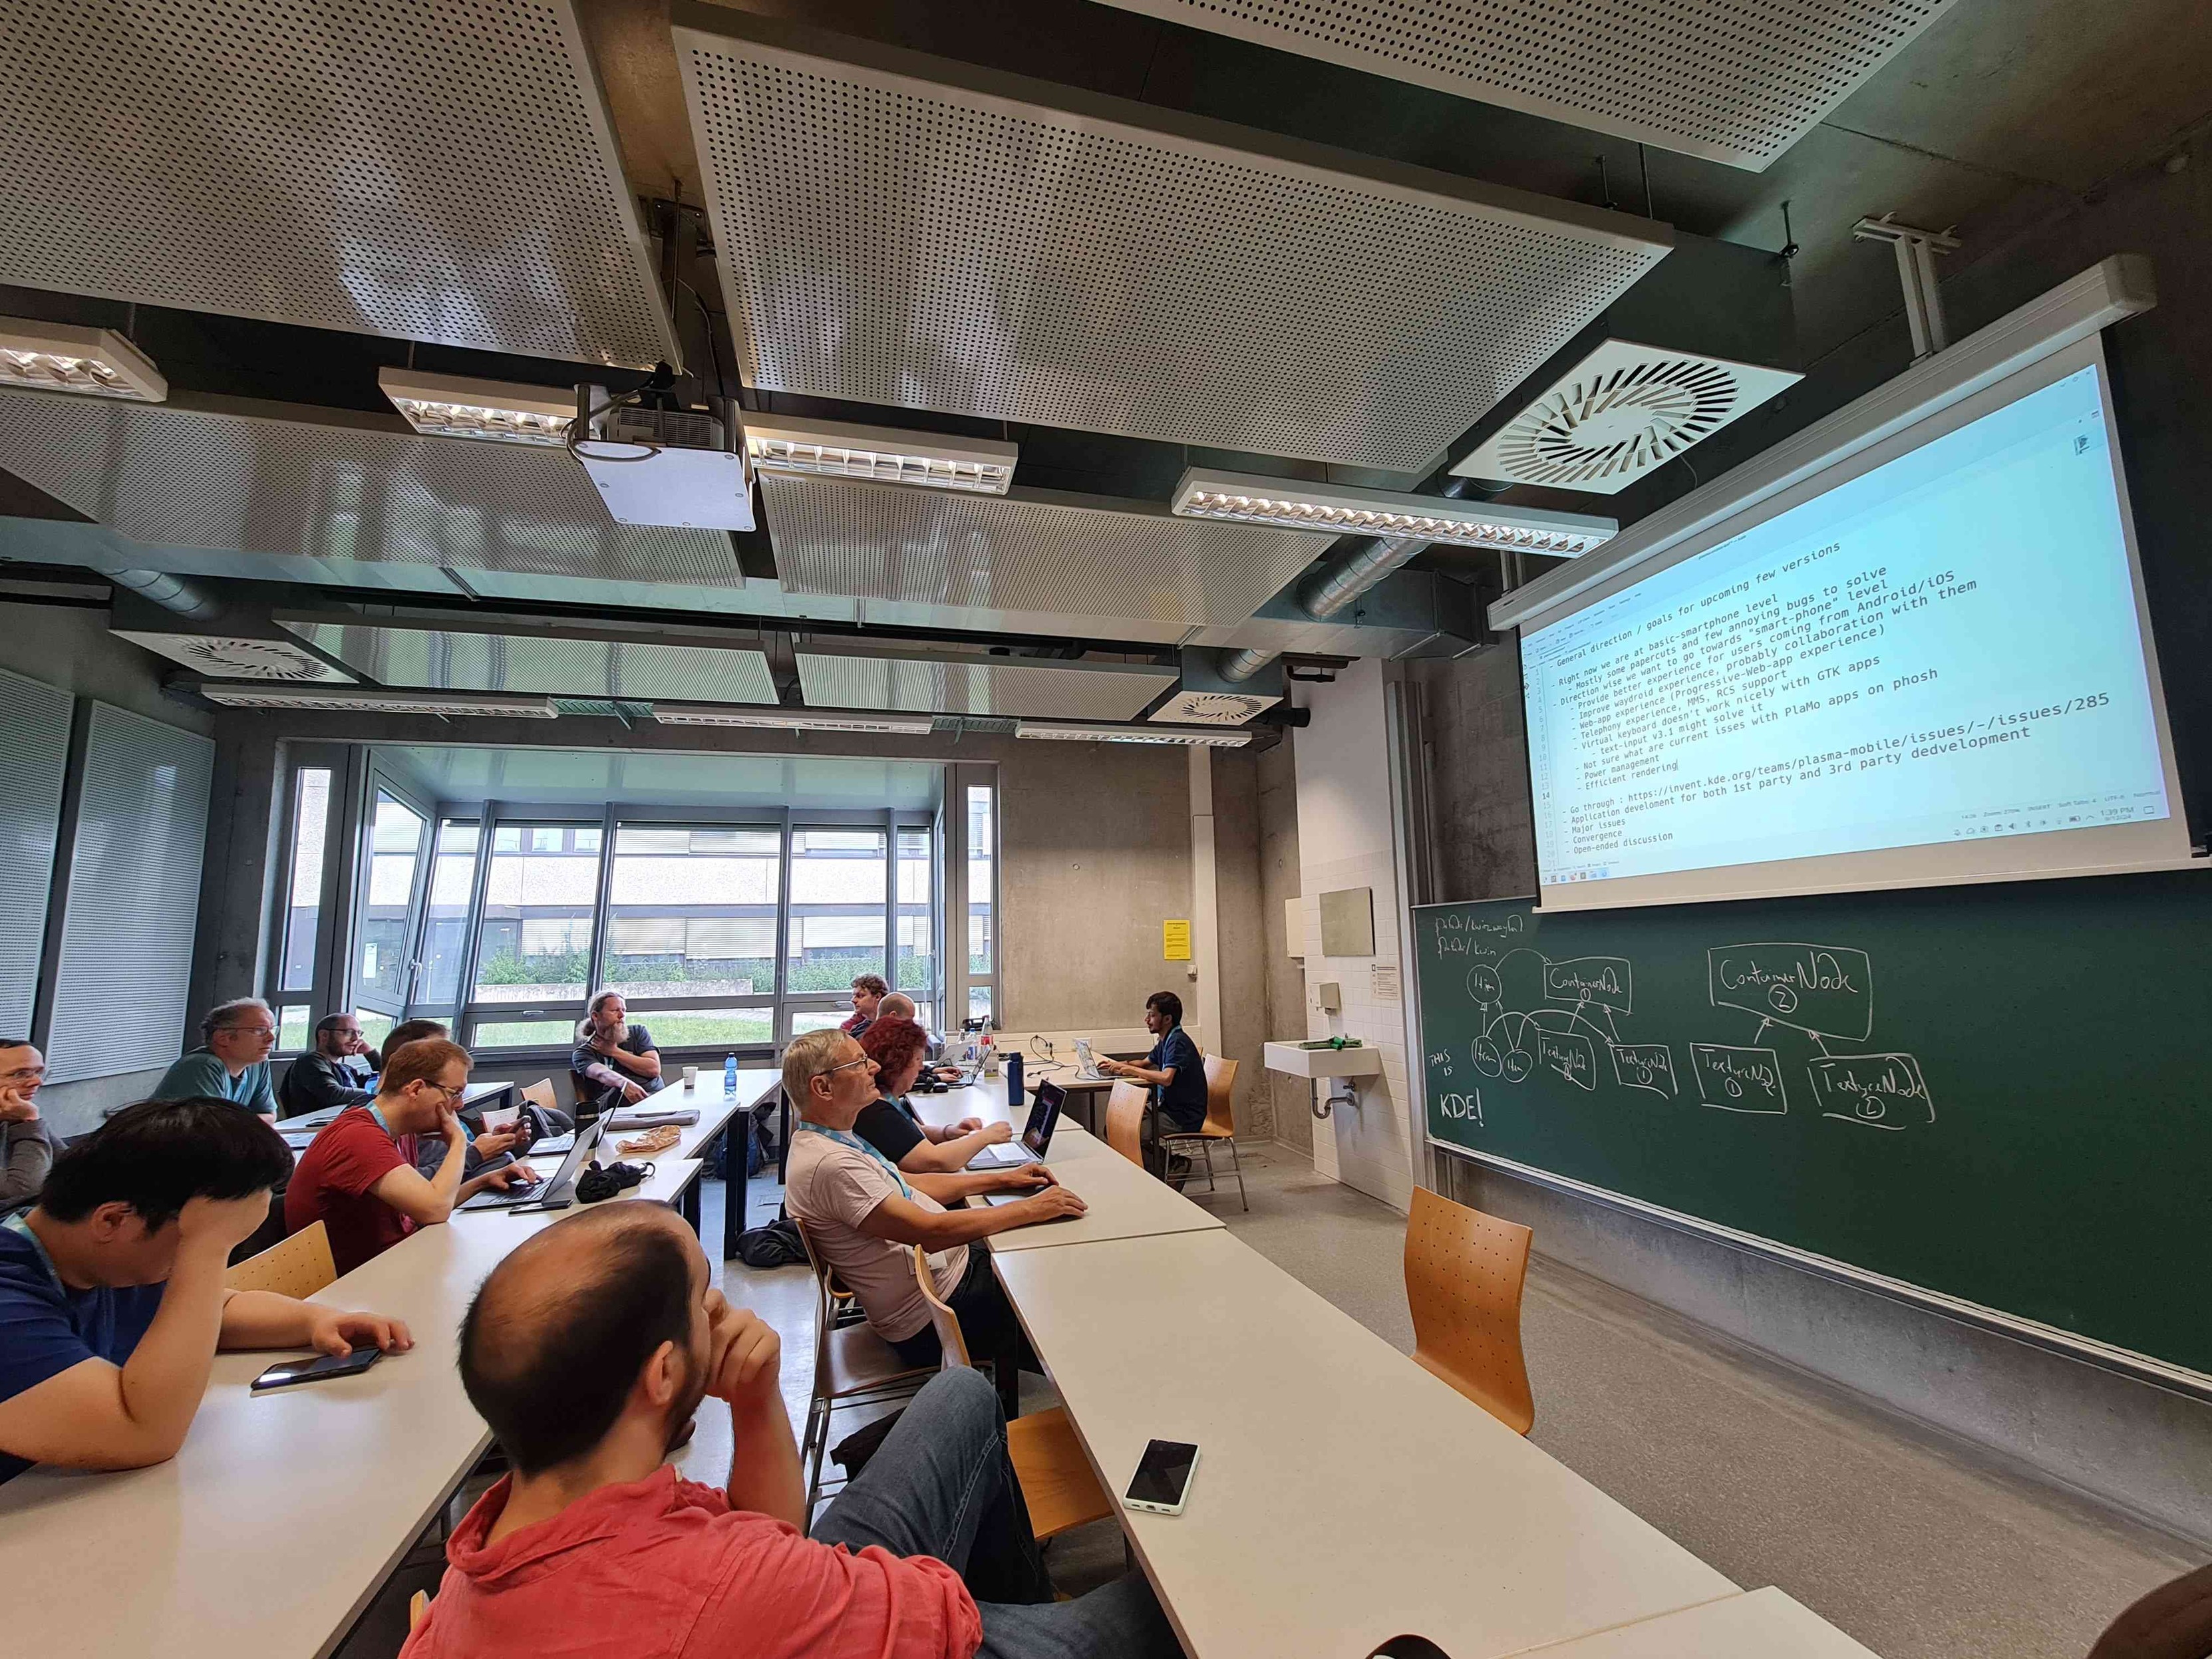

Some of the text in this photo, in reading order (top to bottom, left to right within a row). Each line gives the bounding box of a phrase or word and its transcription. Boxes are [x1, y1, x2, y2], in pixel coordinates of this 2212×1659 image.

[1557, 649, 1586, 667] General
[1591, 631, 1632, 653] direction
[1647, 613, 1672, 631] goals
[1678, 604, 1694, 616] for
[1700, 581, 1749, 607] upcoming
[1756, 569, 1775, 583] few
[1782, 543, 1839, 572] versions
[1559, 673, 1579, 686] Right
[1584, 666, 1597, 676] now
[1615, 654, 1629, 664] are
[1634, 647, 1643, 657] at
[1649, 611, 1739, 651] basic-smartphone
[1746, 593, 1778, 613] level
[1561, 686, 1599, 705] Direction
[1603, 679, 1622, 689] wise
[1641, 663, 1660, 676] want
[1683, 652, 1694, 663] go
[1700, 635, 1741, 655] towards
[1749, 597, 1837, 635] "smart-phone"
[1847, 579, 1888, 601] level
[1576, 675, 1602, 689] Mostly
[1607, 666, 1625, 678] some
[1630, 647, 1676, 671] papercuts
[1682, 636, 1698, 650] and
[1704, 629, 1722, 641] few
[1728, 607, 1780, 632] annoying
[1787, 594, 1815, 611] bugs
[1822, 585, 1837, 596] to
[1846, 567, 1886, 588] solve
[1578, 693, 1609, 709] Provide
[1613, 682, 1641, 697] better
[1647, 661, 1700, 685] experience
[1708, 653, 1724, 664] for
[1731, 640, 1762, 656] users
[1770, 622, 1811, 643] coming
[1819, 609, 1849, 625] from
[1857, 570, 1954, 613] Android/iOS
[1579, 704, 1610, 719] Improve
[1614, 688, 1653, 707] waydroid
[1659, 669, 1718, 692] experience,
[1726, 647, 1777, 672] probably
[1785, 611, 1883, 651] collaboration
[1891, 595, 1927, 615] with
[1937, 580, 1976, 599] them
[1579, 714, 1611, 729] Web-app
[1615, 696, 1664, 718] experience
[1670, 656, 1792, 700] (Progressive-Web-app
[1800, 623, 1883, 659] experience)
[1581, 734, 1613, 749] Virtual
[1617, 720, 1656, 738] keyboard
[1662, 708, 1699, 726] doesn't
[1706, 700, 1730, 713] work
[1736, 686, 1774, 704] nicely
[1782, 676, 1810, 690] with
[1817, 665, 1840, 680] GTK
[1848, 656, 1879, 672] apps
[1581, 722, 1621, 739] Telephony
[1626, 704, 1680, 725] experience,
[1687, 694, 1709, 706] MMS,
[1716, 685, 1735, 698] RCS
[1742, 669, 1787, 690] support
[1583, 760, 1596, 769] Not
[1601, 755, 1619, 765] sure
[1624, 748, 1643, 758] what
[1649, 743, 1663, 752] are
[1670, 730, 1708, 746] current
[1716, 722, 1745, 734] isses
[1751, 711, 1778, 725] with
[1785, 700, 1820, 716] PlaMo
[1829, 690, 1858, 705] apps
[1868, 684, 1883, 694] on
[1893, 669, 1937, 690] phosh
[1583, 798, 1614, 811] through
[1629, 692, 2109, 802] https://invent.kde.org/teams/plasma-mobile/issues/-/issues/285
[1585, 769, 1606, 779] Power
[1611, 755, 1659, 772] management
[1601, 736, 1647, 754] text-input
[1653, 727, 1673, 739] v3.1
[1678, 718, 1706, 732] might
[1714, 709, 1743, 723] solve
[1752, 702, 1762, 712] it
[1571, 809, 1620, 824] Application
[1625, 797, 1674, 813] develoment
[1681, 793, 1696, 802] for
[1703, 786, 1726, 798] both
[1734, 782, 1751, 792] 1st
[1759, 774, 1792, 790] party
[1800, 767, 1820, 780] and
[1829, 760, 1851, 774] 3rd
[1860, 753, 1901, 770] party
[1911, 726, 2030, 758] dedvelopment
[1585, 774, 1626, 790] Efficient
[1631, 762, 1676, 778] rendering
[1571, 824, 1593, 833] Major
[1599, 818, 1625, 829] issues
[1573, 830, 1622, 843] Convergence
[1573, 840, 1618, 854] Open-ended
[1623, 833, 1672, 846] discussion
[1429, 1048, 1450, 1066] THIS
[1444, 1066, 1453, 1076] IS
[1440, 1088, 1484, 1127] KDE!
